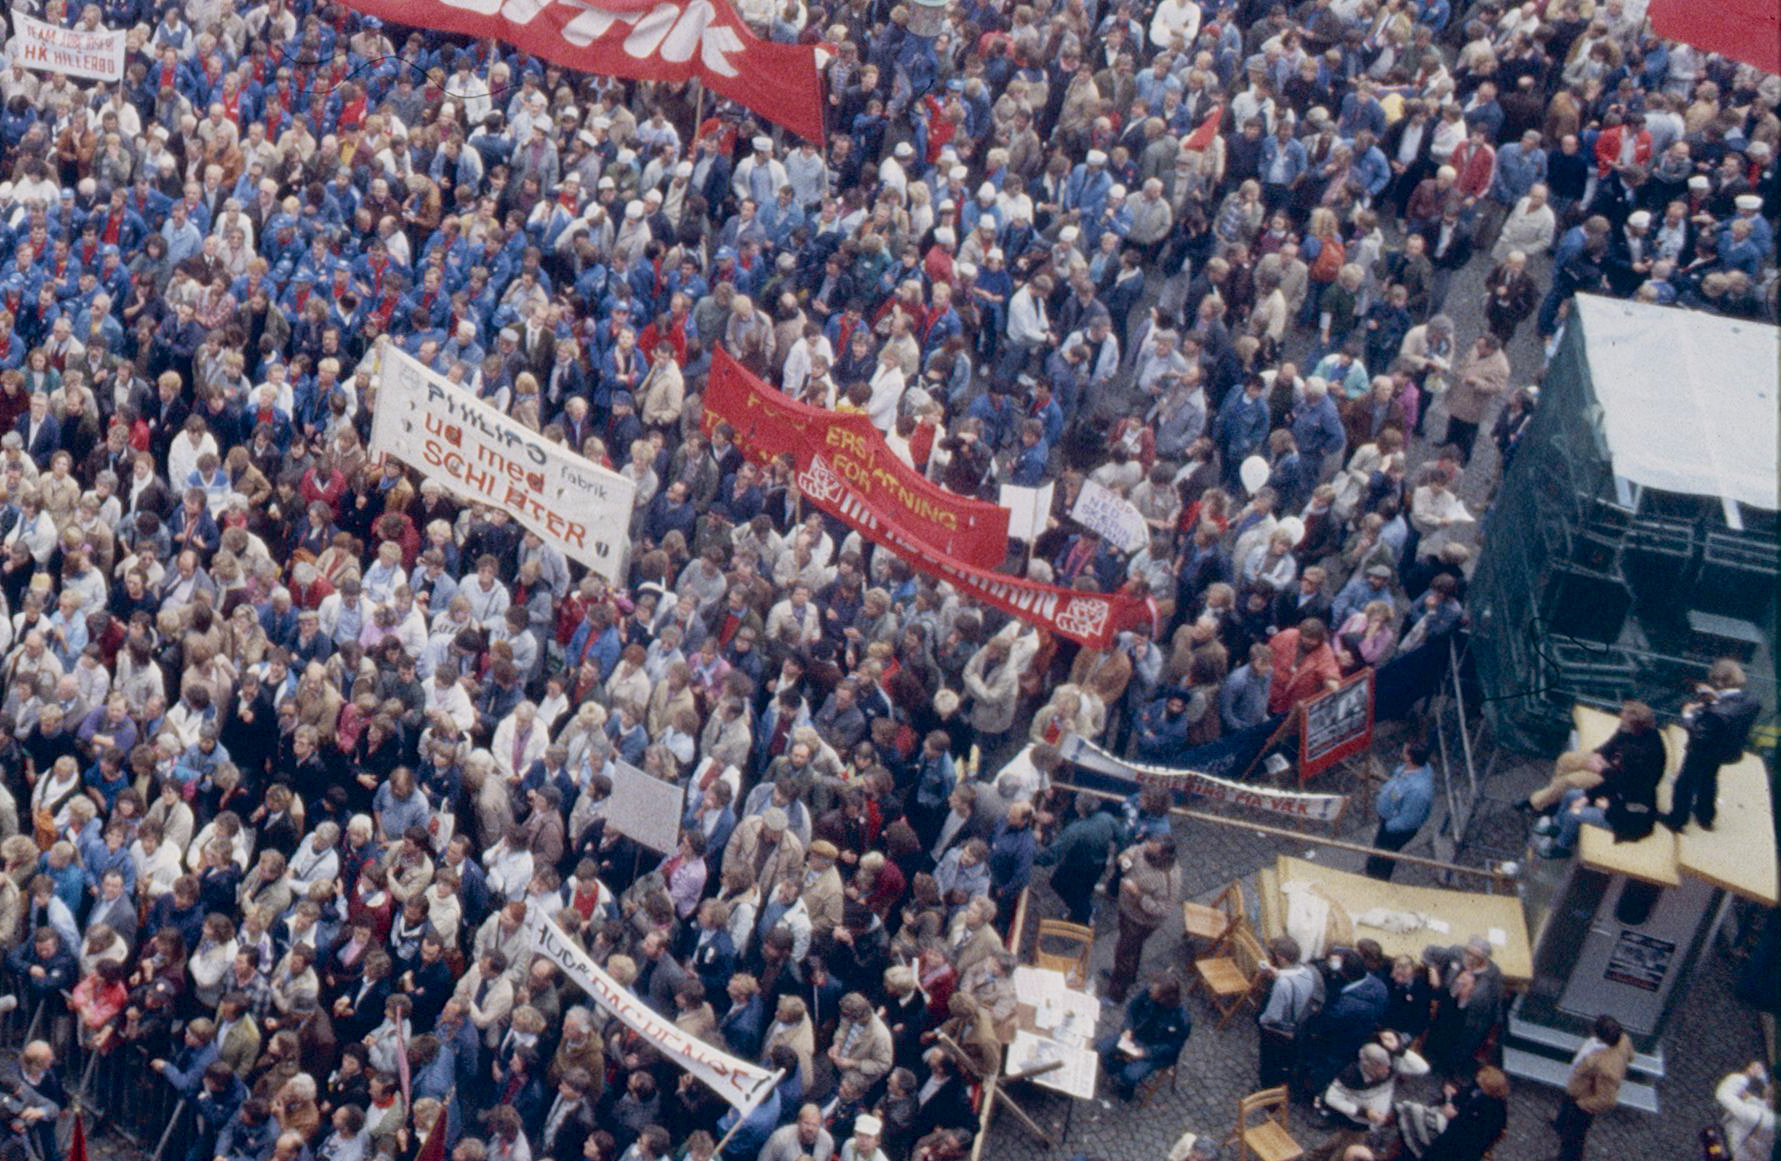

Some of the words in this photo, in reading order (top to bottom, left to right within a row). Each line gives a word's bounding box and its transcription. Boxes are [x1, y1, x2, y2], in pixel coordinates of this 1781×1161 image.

[24, 44, 48, 62] HK
[423, 411, 463, 449] ud
[477, 442, 546, 495] med
[560, 466, 609, 500] fabrik
